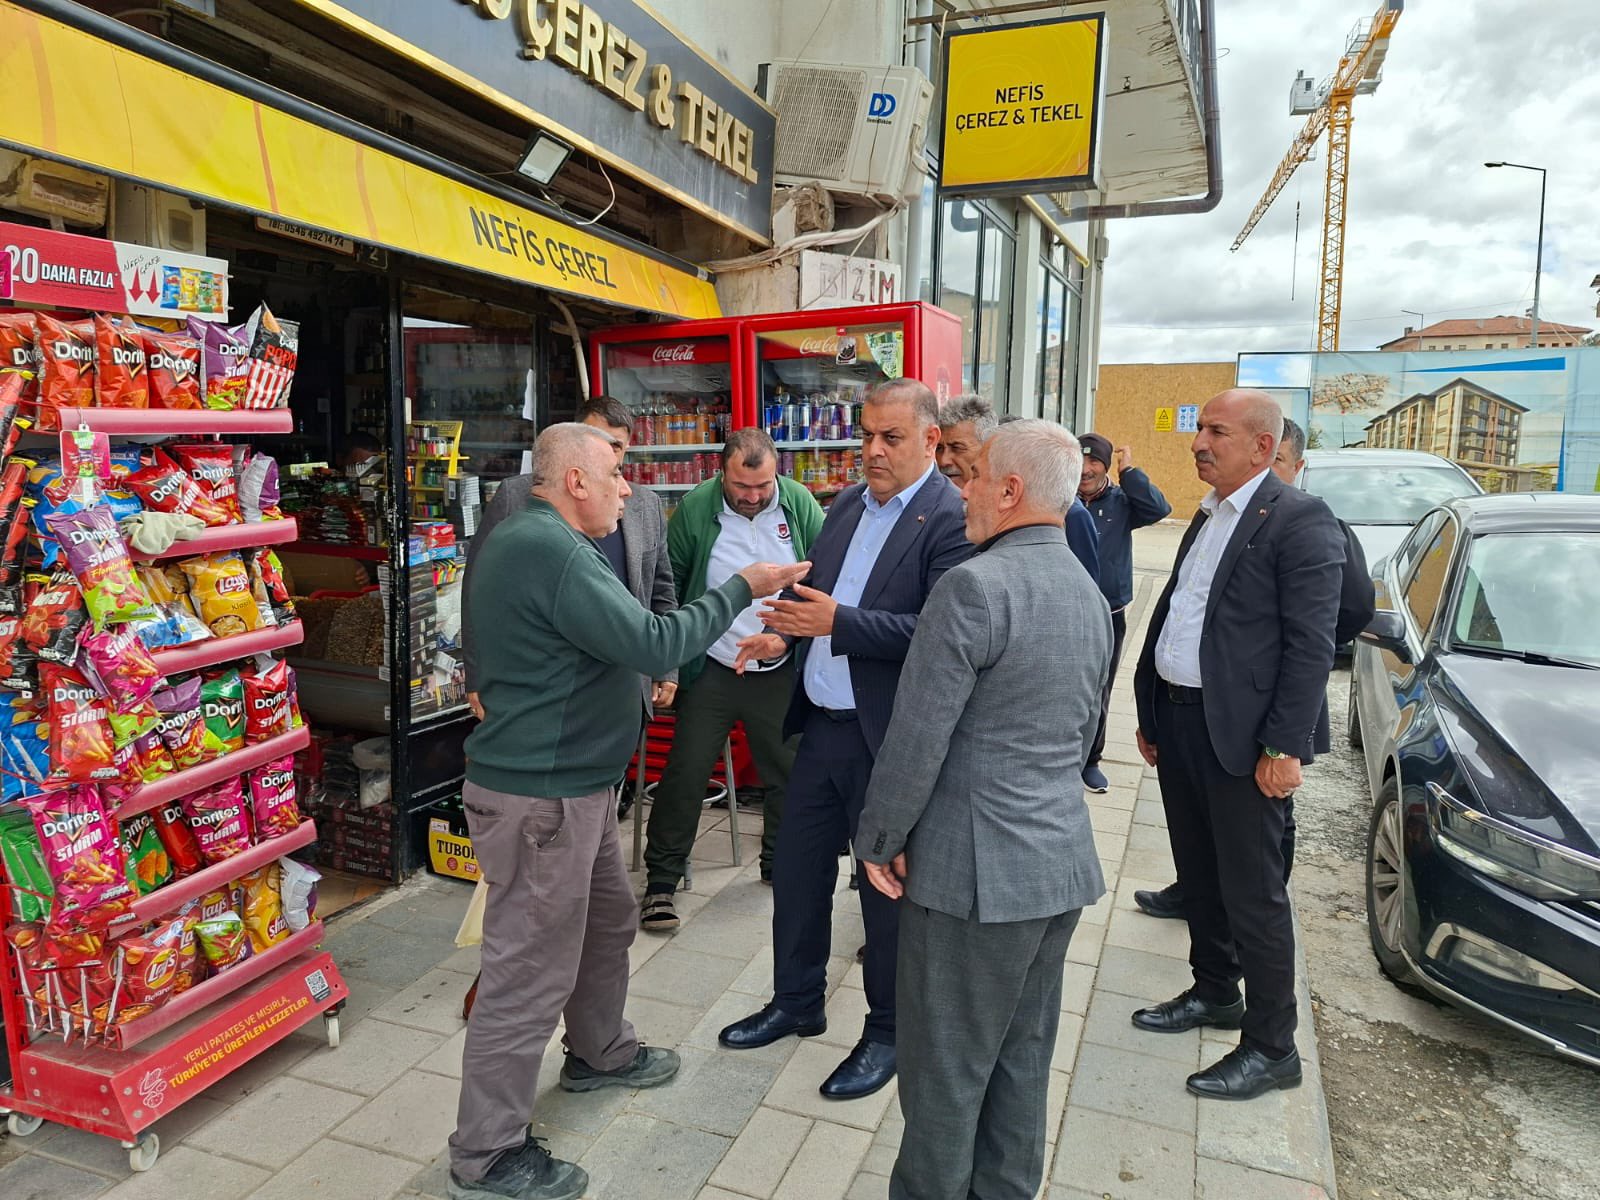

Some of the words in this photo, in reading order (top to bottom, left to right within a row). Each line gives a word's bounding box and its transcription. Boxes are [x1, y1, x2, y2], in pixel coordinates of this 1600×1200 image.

[520, 0, 647, 112] ÇEREZ
[650, 63, 675, 130] &
[678, 81, 757, 184] TEKEL
[994, 81, 1044, 104] NEFİS
[955, 110, 1009, 134] ÇEREZ
[1012, 108, 1025, 125] &
[1030, 103, 1083, 123] TEKEL
[307, 231, 323, 242] 492
[469, 206, 545, 266] NEFİS
[545, 237, 618, 290] ÇEREZ
[41, 262, 77, 284] DAHA
[42, 810, 101, 838] Doritos
[191, 805, 241, 828] Doritos
[55, 828, 103, 863] STORM
[169, 1050, 226, 1088] TÜRKİYE'DE
[224, 1021, 267, 1054] ÜRETİLEN
[266, 996, 310, 1029] LEZZETLER
[184, 1041, 209, 1064] YERLİ
[208, 1021, 246, 1049] PATATES
[244, 1011, 257, 1027] VE
